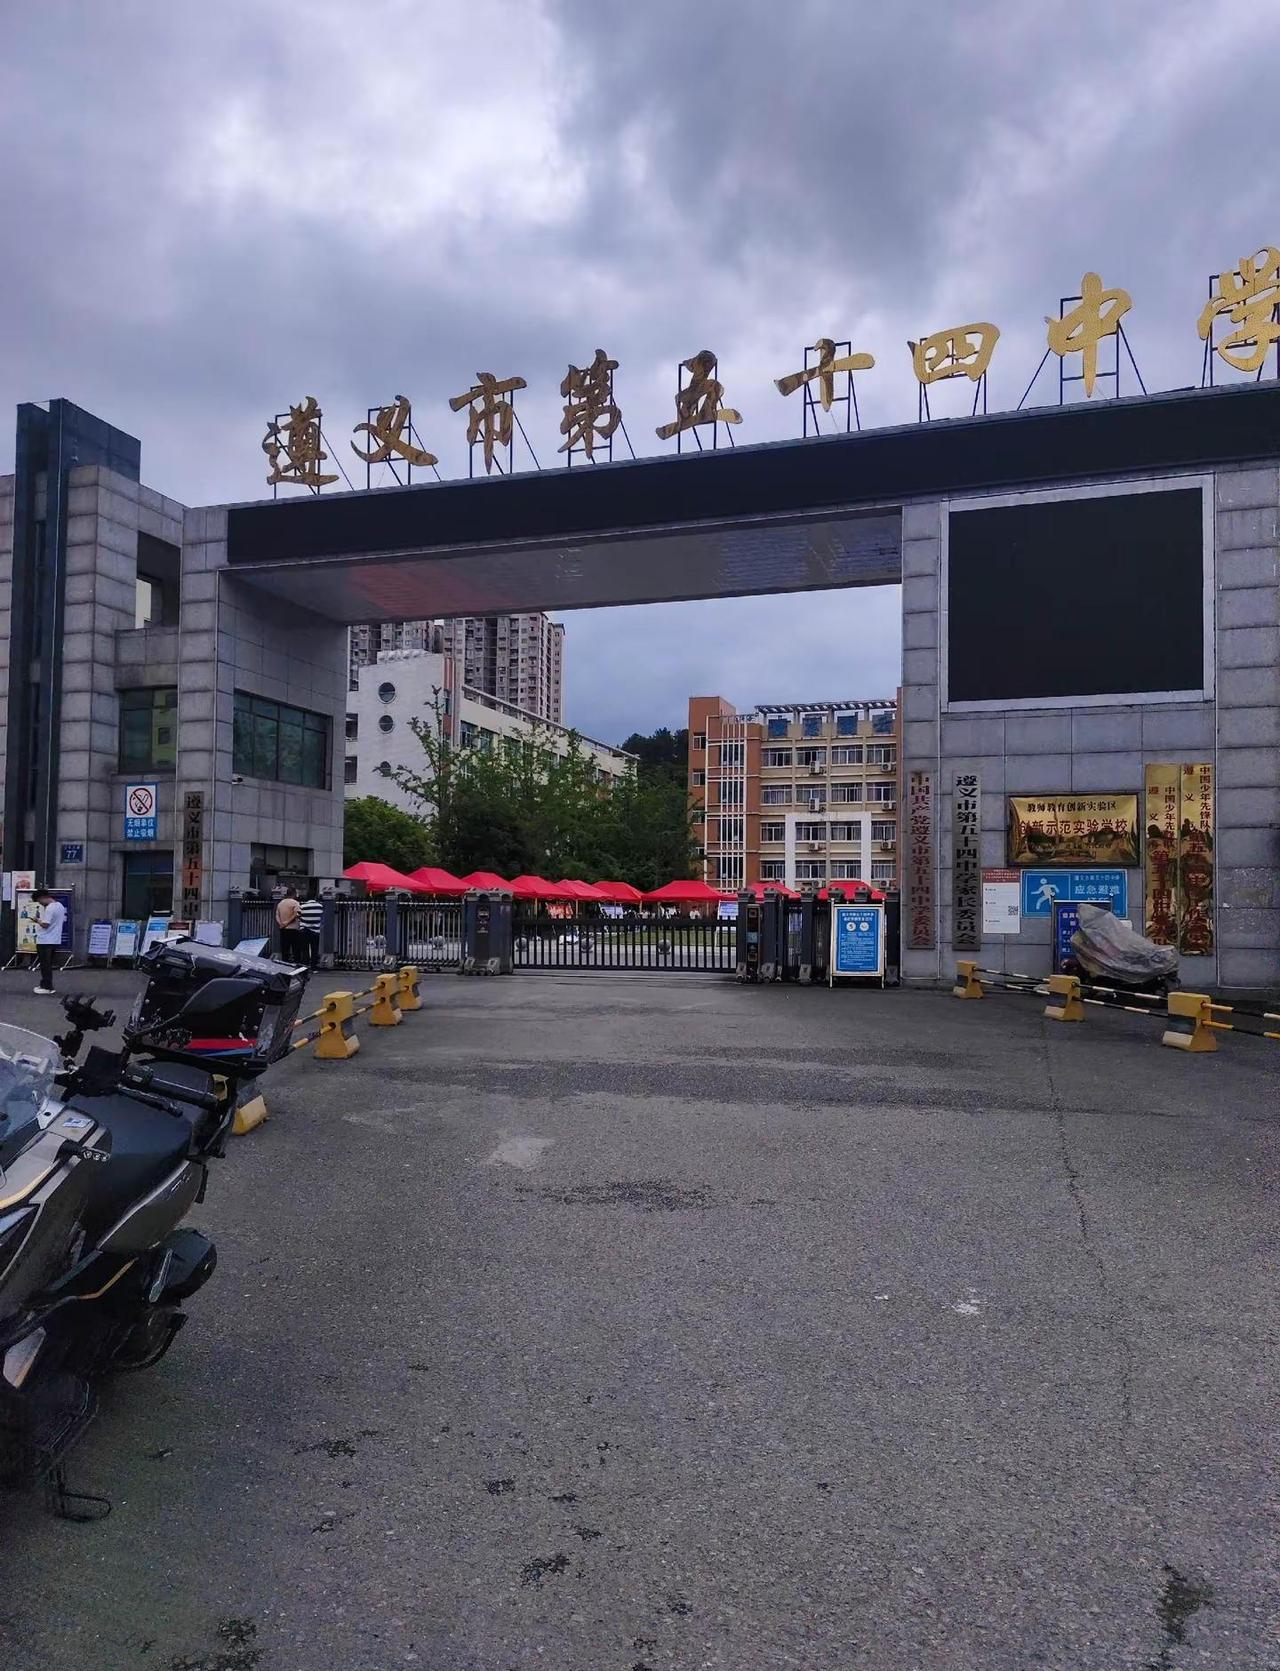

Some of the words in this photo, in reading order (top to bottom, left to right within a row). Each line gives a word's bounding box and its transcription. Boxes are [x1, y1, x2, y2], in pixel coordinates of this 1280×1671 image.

[263, 246, 1280, 486] 遵义市第五十四中学
[1027, 801, 1117, 812] 教师教育创新实验区
[1200, 766, 1211, 831] 中国少年先锋队
[127, 828, 154, 838] 禁止吸烟
[1019, 818, 1128, 837] 创新示范实验学校
[66, 850, 77, 859] 77
[911, 772, 931, 945] 中国共产党遵义市第五十四中学委员会
[956, 775, 978, 944] 遵义市第五十四中学家长委员会
[1074, 885, 1120, 895] 应急避难
